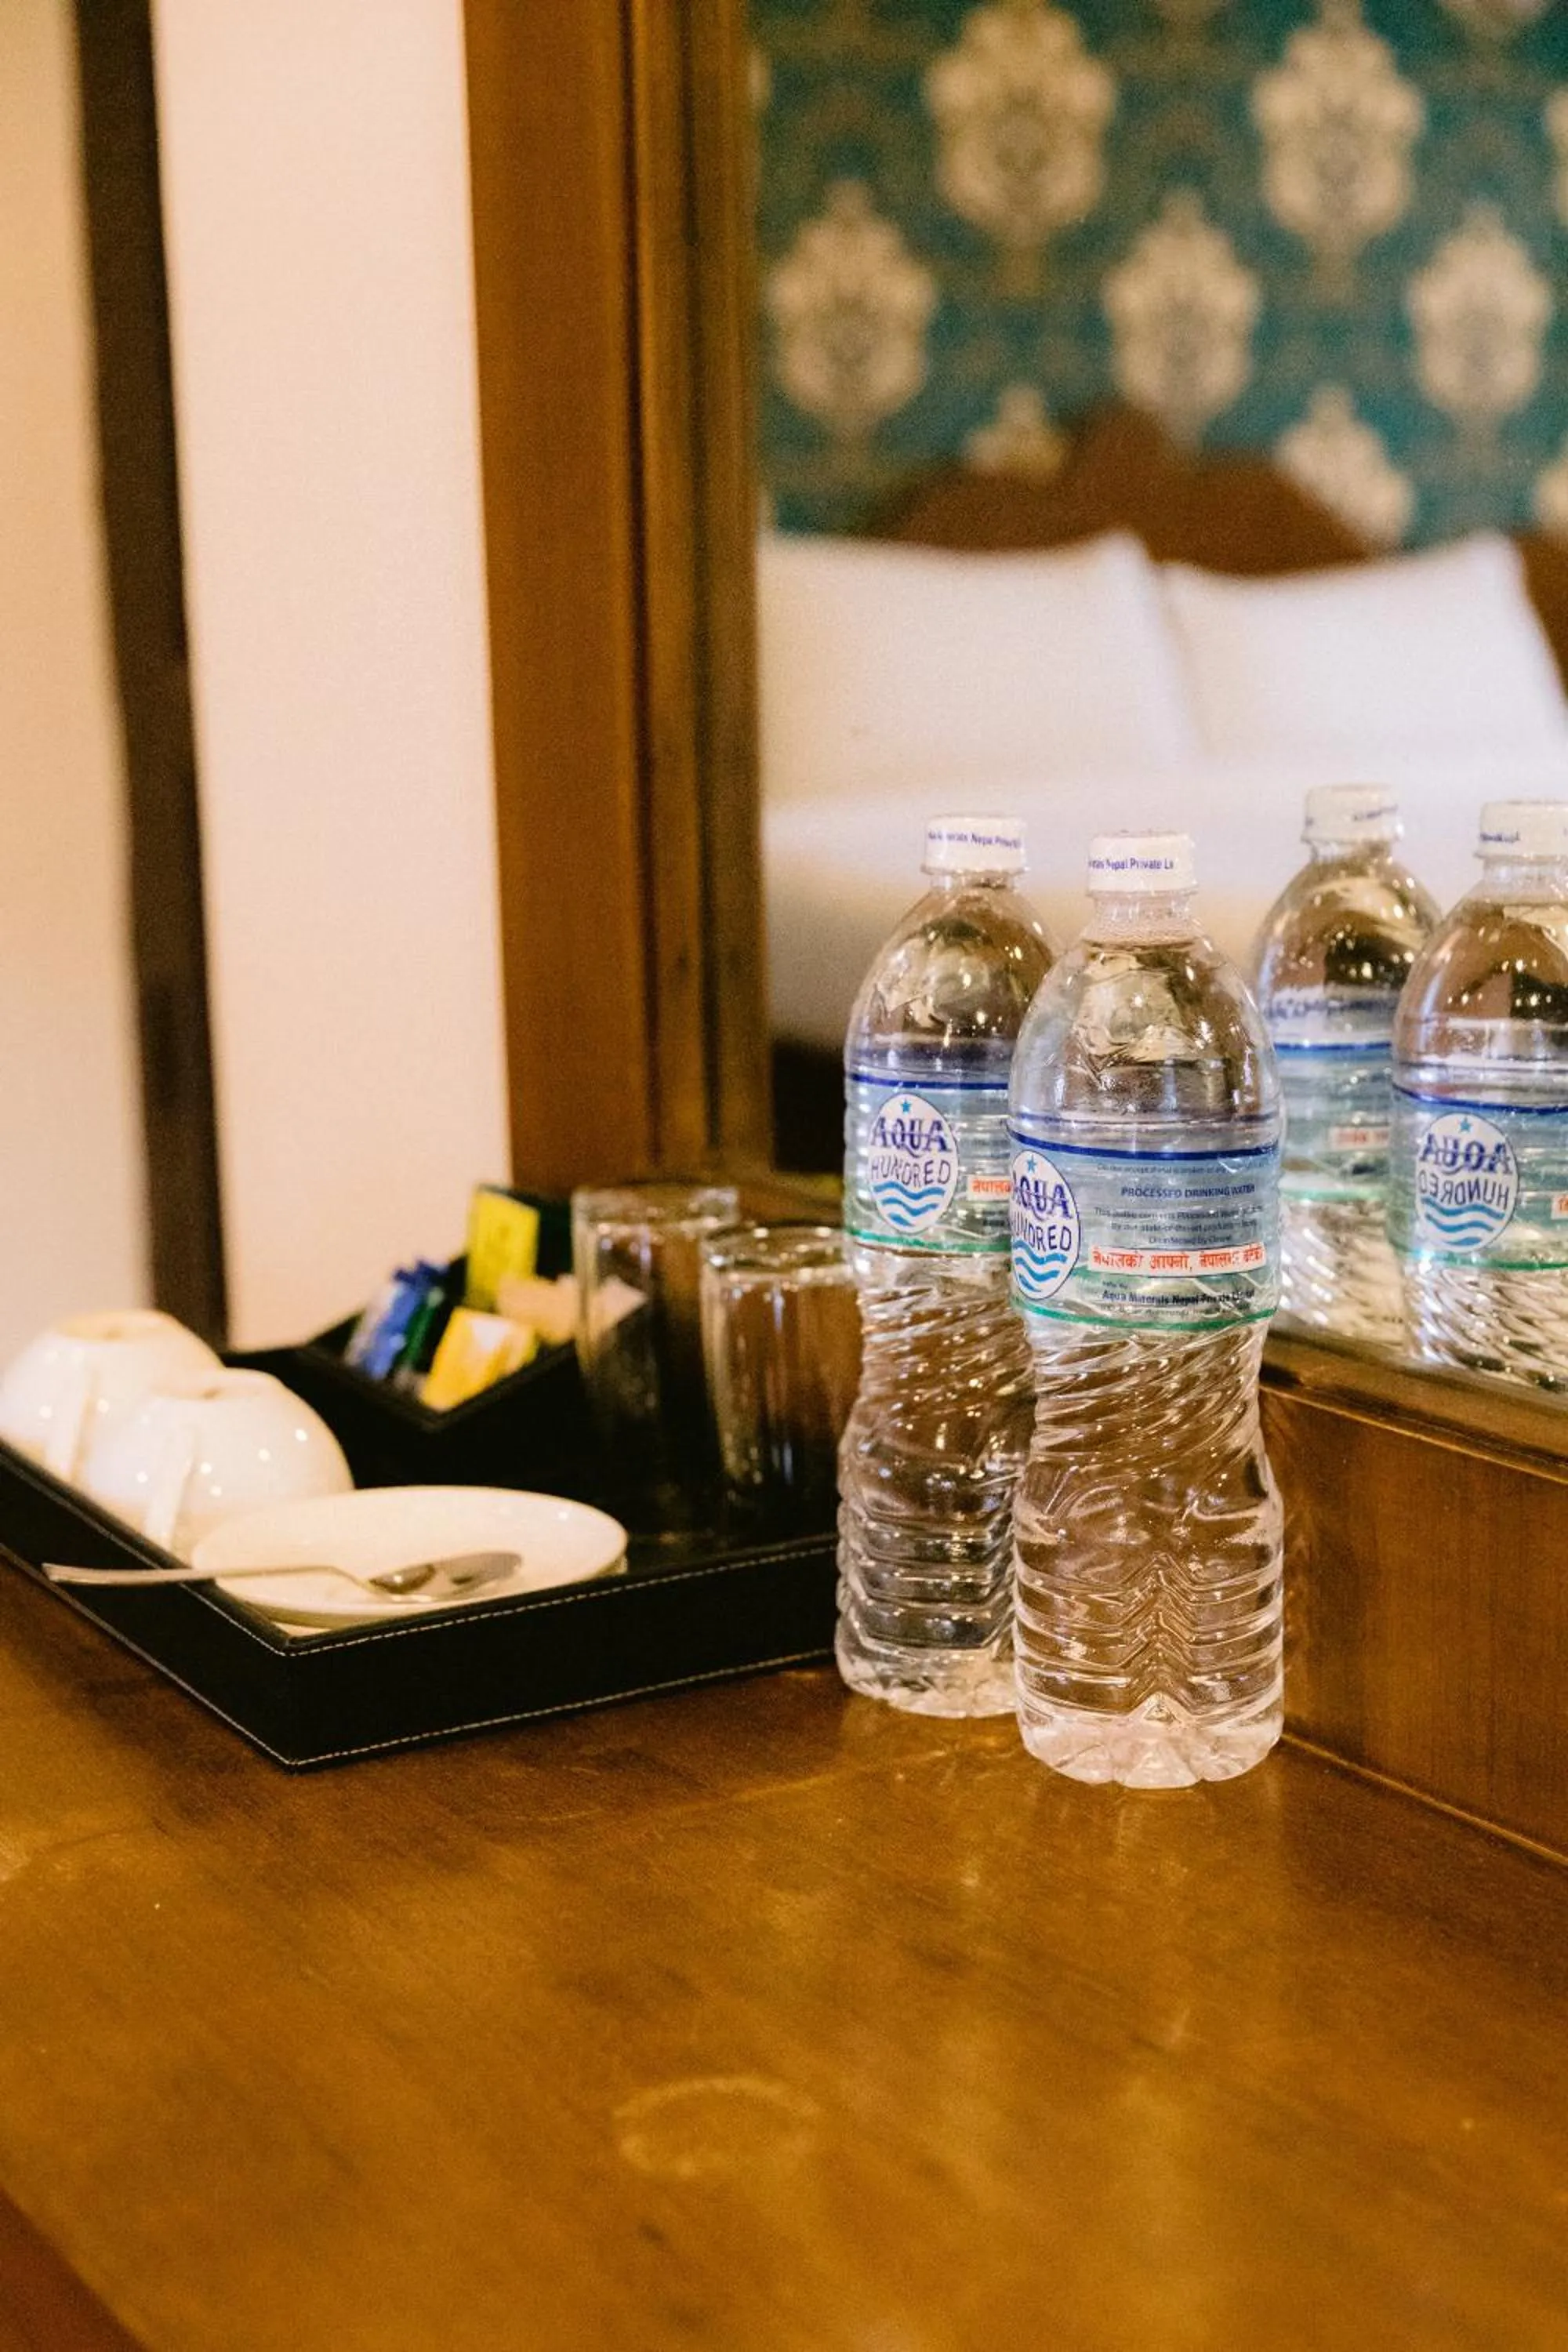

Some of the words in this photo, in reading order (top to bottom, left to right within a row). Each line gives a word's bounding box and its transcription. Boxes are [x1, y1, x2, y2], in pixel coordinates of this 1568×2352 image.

[1130, 857, 1162, 869] Private
[871, 1116, 953, 1158] AQUA
[871, 1154, 951, 1187] HUNDRED
[1012, 1170, 1073, 1220] AQUA
[1121, 1186, 1182, 1199] PROCESSED
[1185, 1185, 1230, 1198] DRINKING
